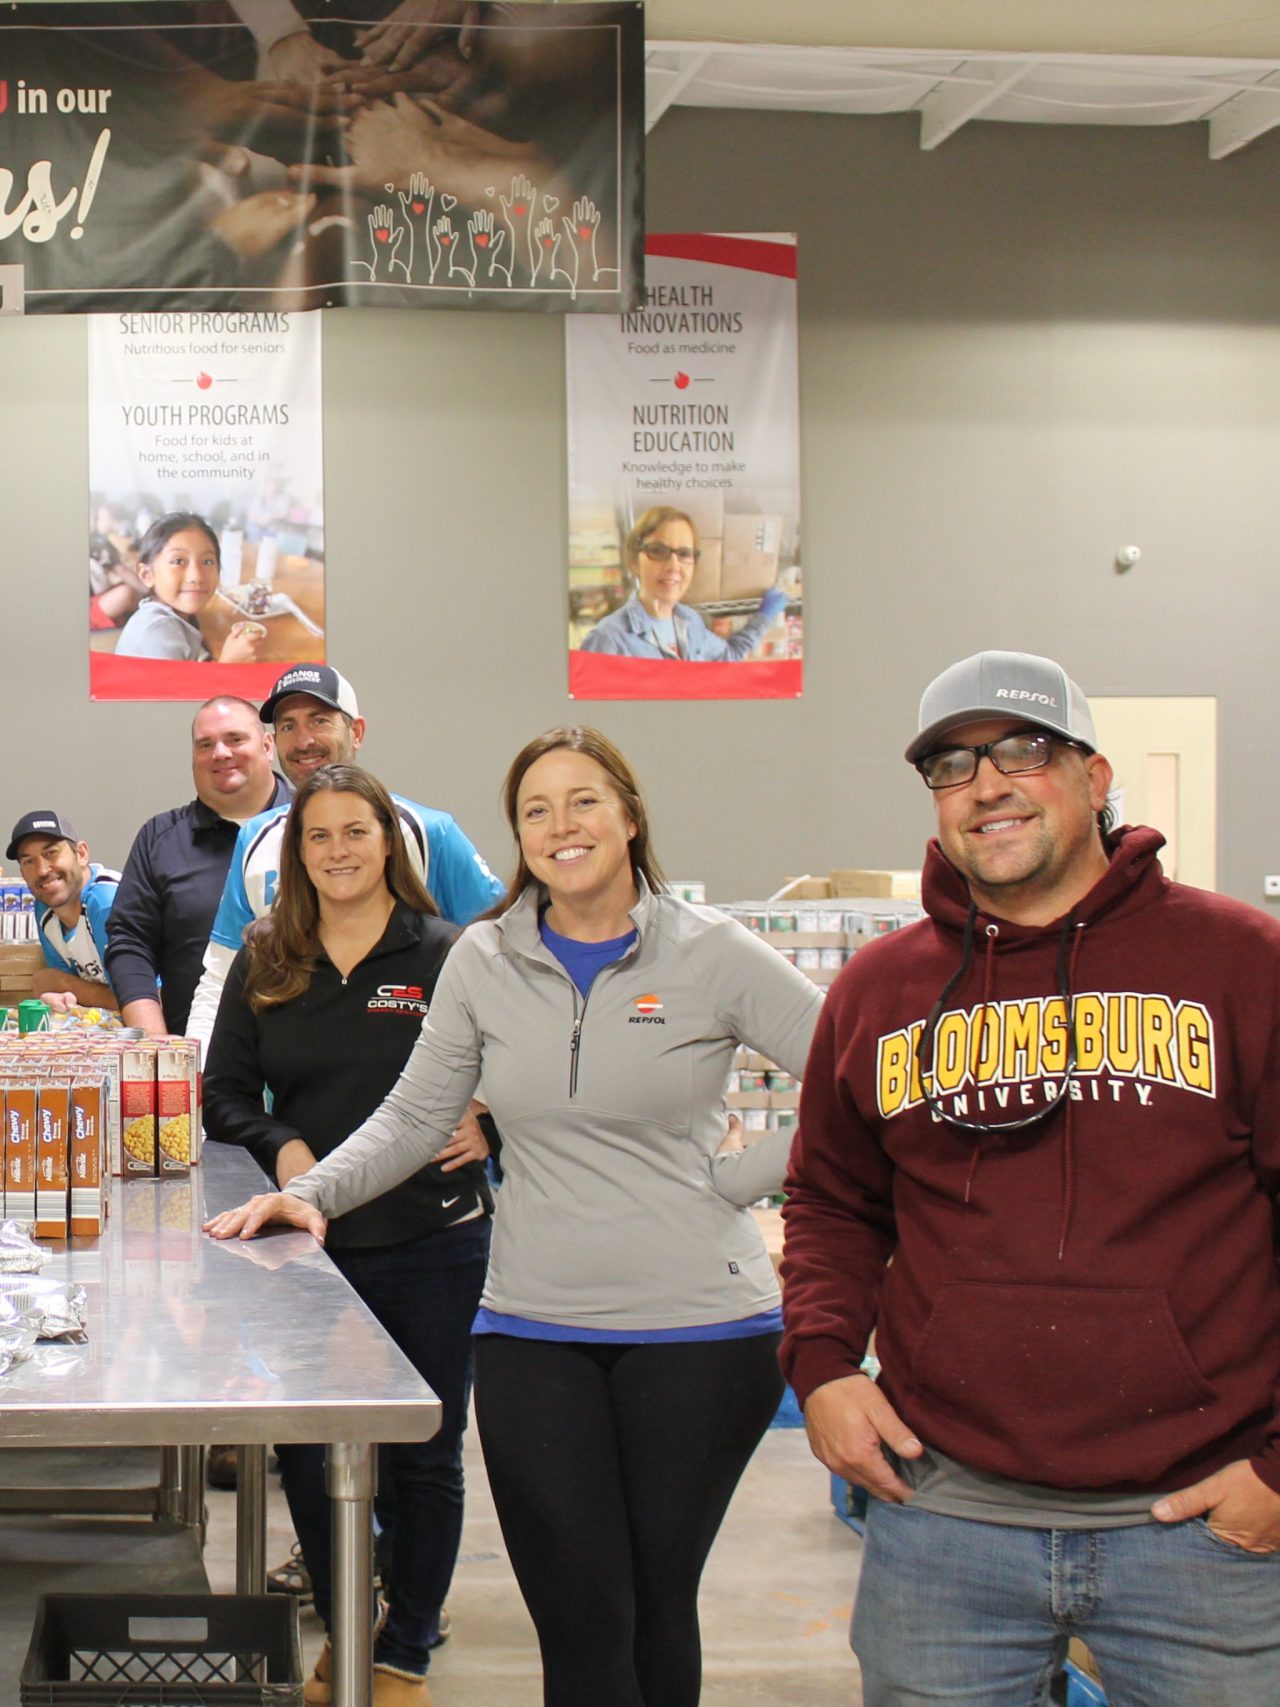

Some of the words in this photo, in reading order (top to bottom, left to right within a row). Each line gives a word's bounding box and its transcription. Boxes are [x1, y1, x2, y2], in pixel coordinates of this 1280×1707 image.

[18, 80, 47, 114] in
[56, 88, 112, 114] our
[645, 285, 713, 306] HEALTH
[119, 313, 184, 334] SENIOR
[189, 312, 290, 333] PROGRAMS
[620, 312, 743, 334] INNOVATIONS
[124, 343, 186, 355] Nutritious
[189, 342, 217, 354] food
[221, 342, 239, 354] for
[241, 342, 286, 354] seniors
[628, 342, 659, 354] Food
[663, 344, 677, 354] as
[679, 342, 736, 354] medicine
[122, 405, 182, 426] YOUTH
[189, 404, 289, 425] PROGRAMS
[633, 404, 728, 425] NUTRITION
[155, 435, 187, 446] Food
[191, 434, 209, 446] for
[212, 434, 237, 446] kids
[241, 436, 253, 446] at
[633, 431, 734, 452] EDUCATION
[139, 451, 179, 464] home,
[183, 451, 227, 464] school,
[230, 450, 254, 462] and
[258, 450, 270, 462] in
[157, 467, 178, 479] the
[181, 467, 255, 480] community
[622, 461, 693, 475] Knowledge
[695, 462, 709, 472] to
[712, 461, 746, 471] make
[636, 477, 682, 490] healthy
[686, 477, 733, 488] choices
[996, 688, 1058, 708] REPSOL
[367, 1000, 428, 1014] COSTY'S
[628, 1016, 665, 1024] REPSOL
[877, 991, 1216, 1120] BLOOMSBURG
[10, 1110, 20, 1143] Chewy
[42, 1109, 53, 1143] Chewy
[75, 1106, 85, 1139] Chewy
